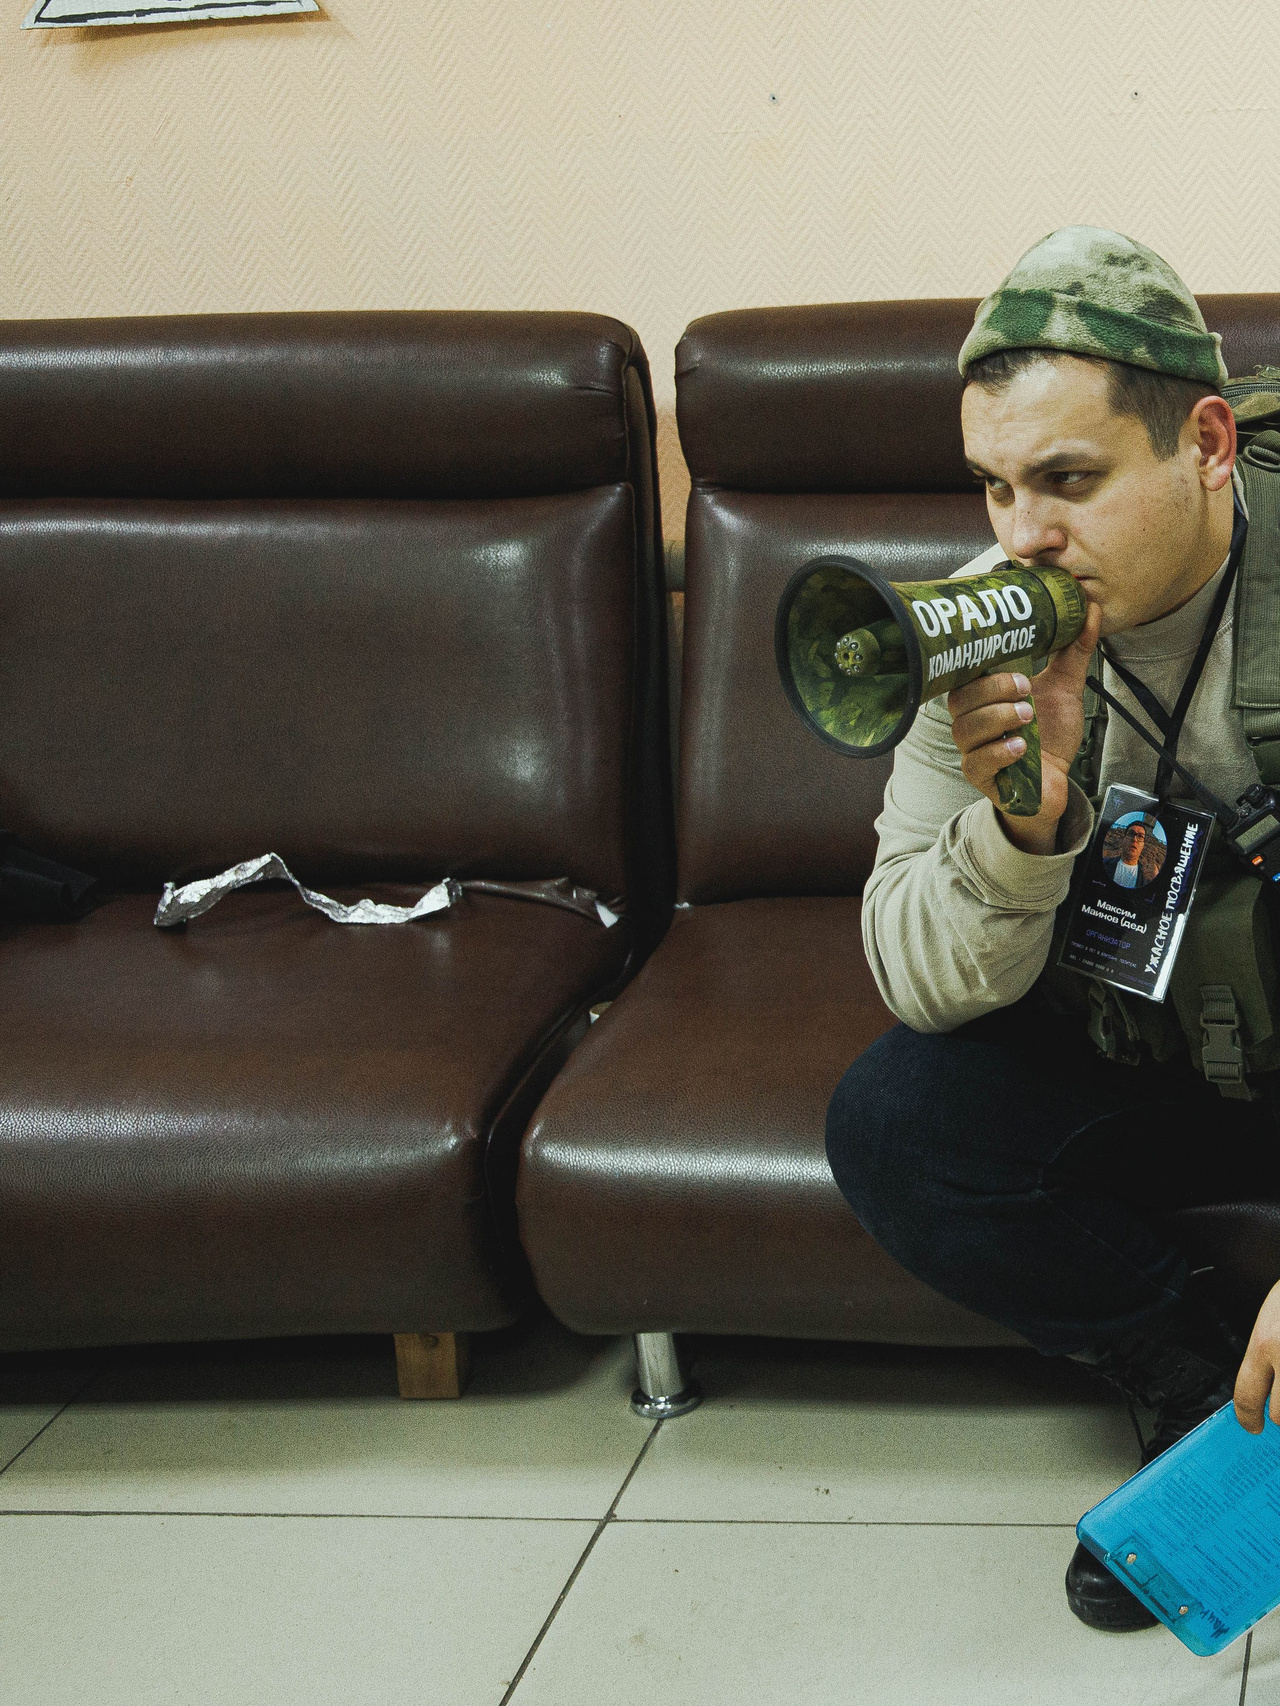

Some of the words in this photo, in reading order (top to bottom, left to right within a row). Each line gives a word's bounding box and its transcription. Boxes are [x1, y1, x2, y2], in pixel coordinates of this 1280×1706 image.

[912, 585, 1033, 637] ОРАЛО
[928, 625, 1036, 682] КОМАНДИРСКОЕ
[1096, 899, 1137, 920] Максим
[1144, 911, 1173, 974] УЖАСНОЕ
[1166, 822, 1199, 911] ПОСВЯЩЕНИЕ
[1085, 928, 1131, 949] ОРГАНИЗАТОР
[1120, 916, 1148, 934] (дед)
